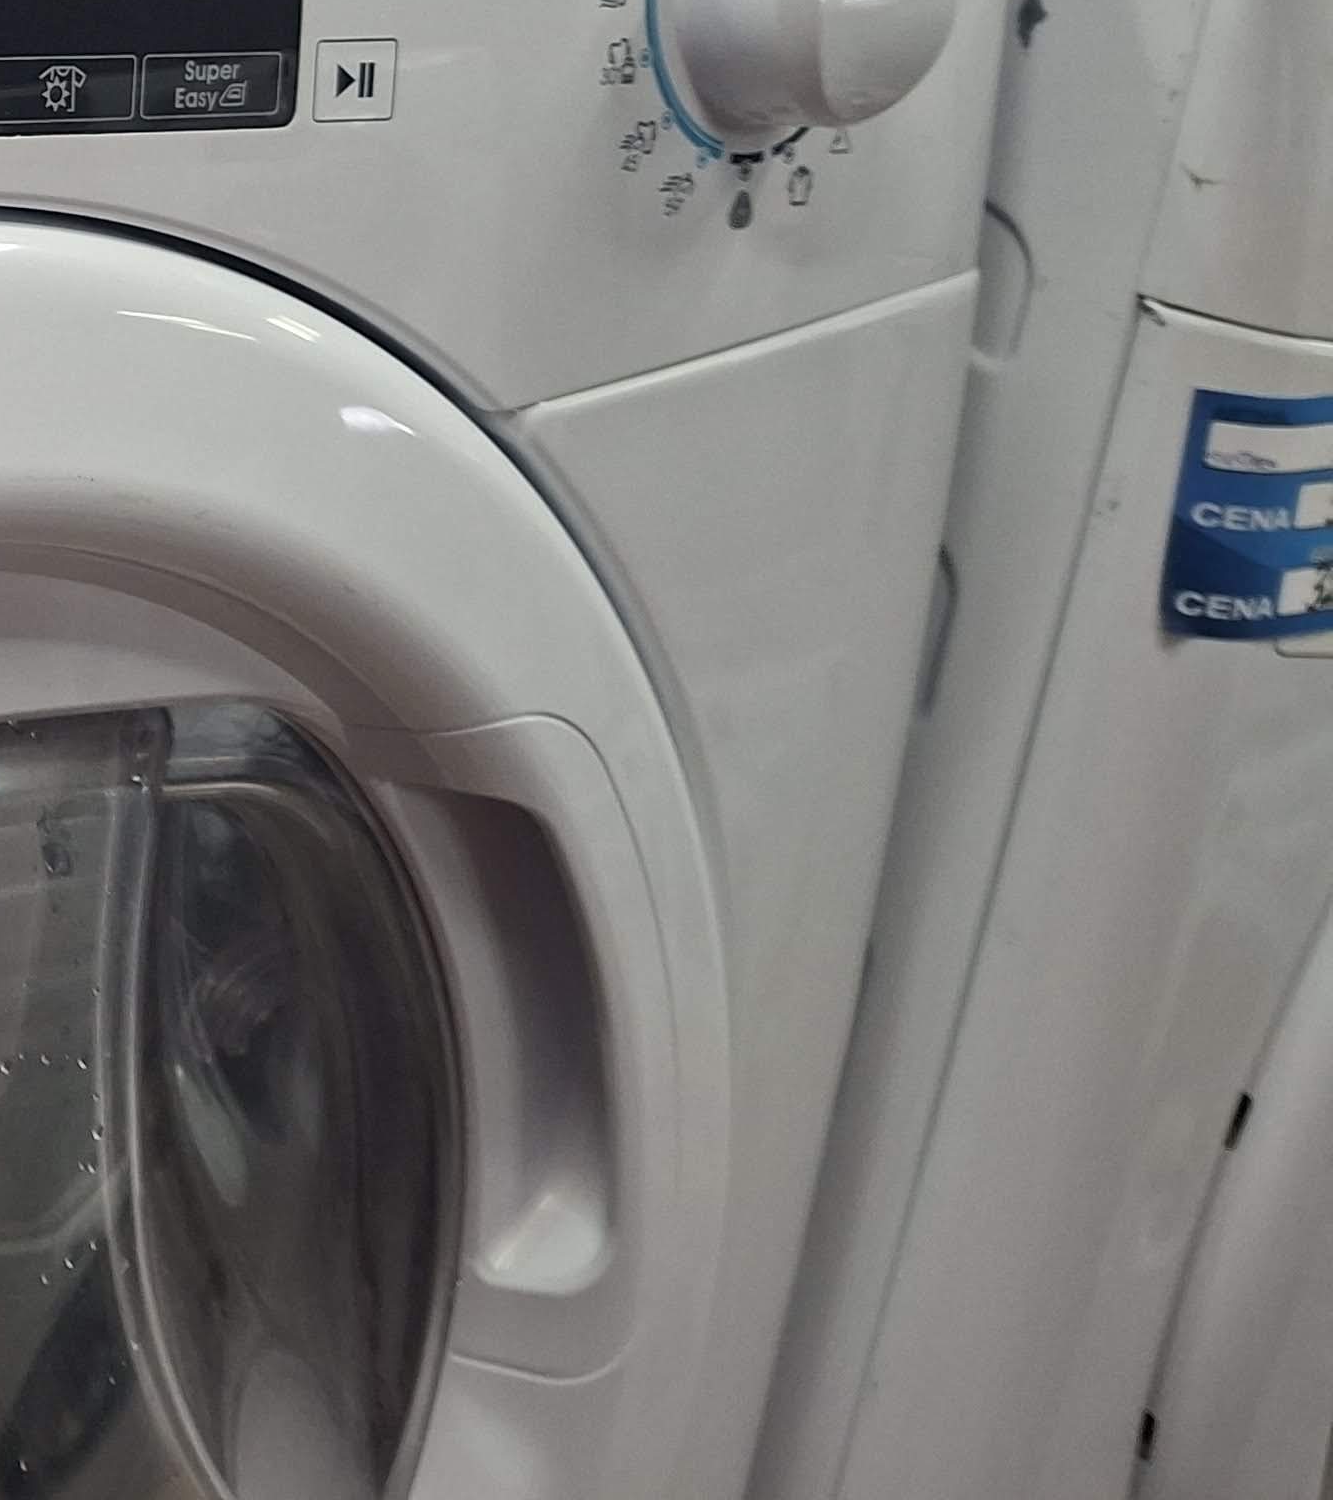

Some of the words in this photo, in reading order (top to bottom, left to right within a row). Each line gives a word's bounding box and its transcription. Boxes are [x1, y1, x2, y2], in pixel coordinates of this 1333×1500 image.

[184, 60, 241, 85] Super
[175, 87, 219, 112] Easy
[1189, 500, 1294, 532] CENA
[1173, 588, 1275, 621] CENA
